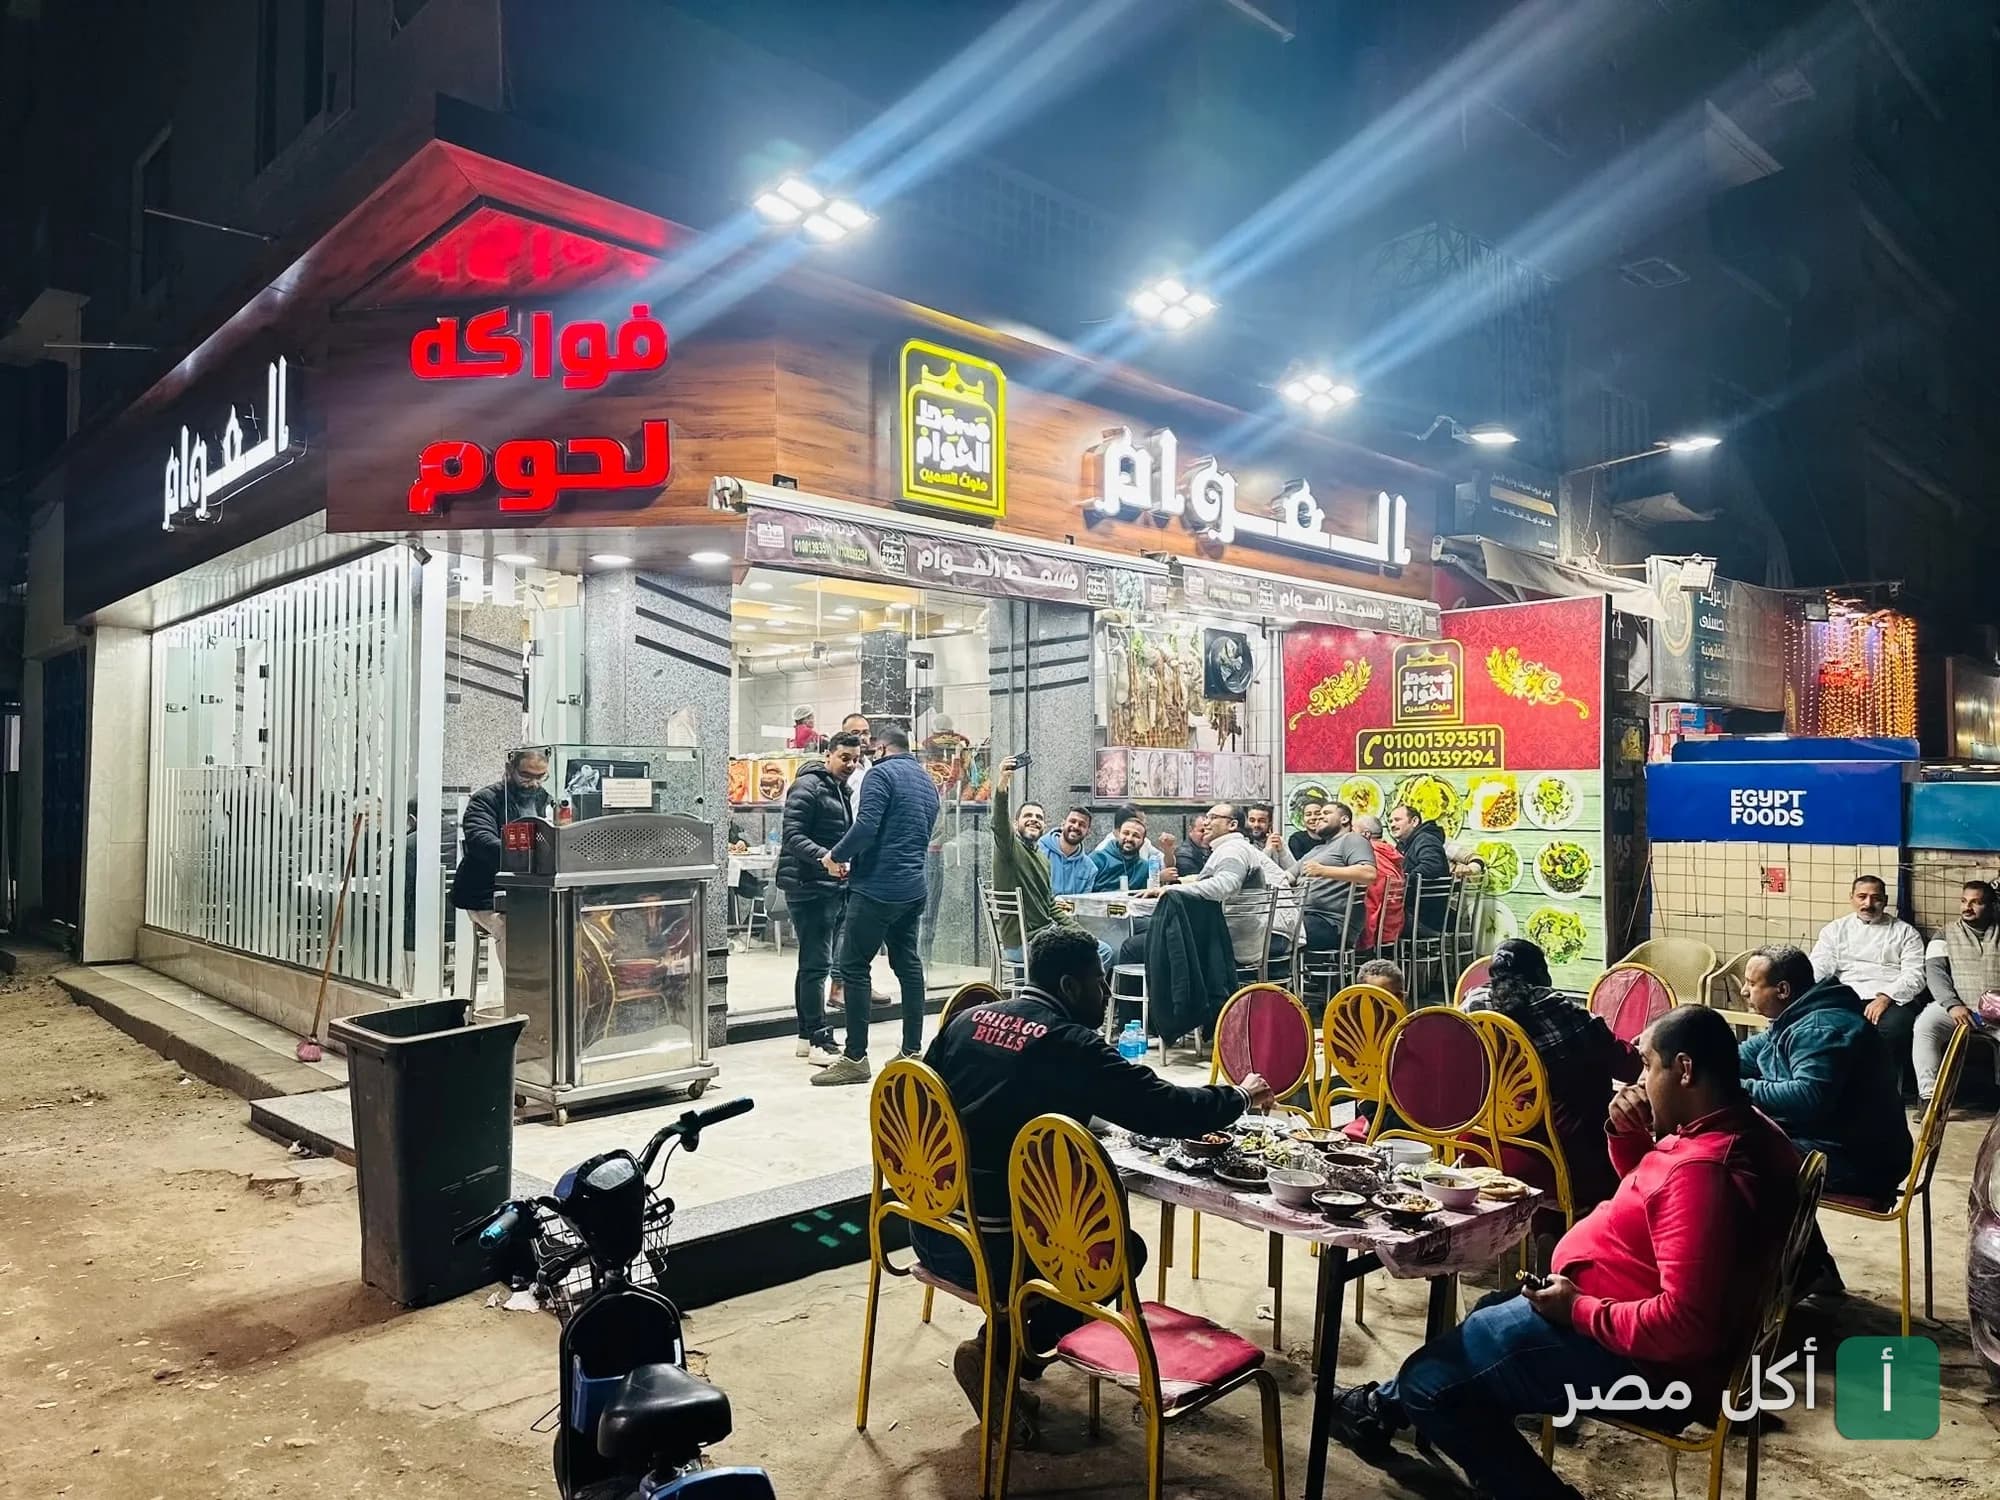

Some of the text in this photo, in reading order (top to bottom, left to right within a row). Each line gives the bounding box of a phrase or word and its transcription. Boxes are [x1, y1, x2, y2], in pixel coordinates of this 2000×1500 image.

[410, 304, 669, 390] فواكه
[162, 355, 289, 531] العوام
[408, 418, 671, 514] لحوم
[1094, 425, 1411, 565] العوام
[917, 546, 1001, 578] العوام
[1004, 558, 1079, 590] مسمط
[1279, 591, 1334, 613] العوام
[1334, 600, 1385, 621] مسمط
[1383, 730, 1496, 749] 01001393511
[1383, 750, 1495, 767] 01100339294
[1730, 789, 1807, 808] EGYPT
[1731, 807, 1804, 827] FOODS
[971, 1009, 1048, 1039] CHICAGO
[971, 1024, 1028, 1052] BULLS
